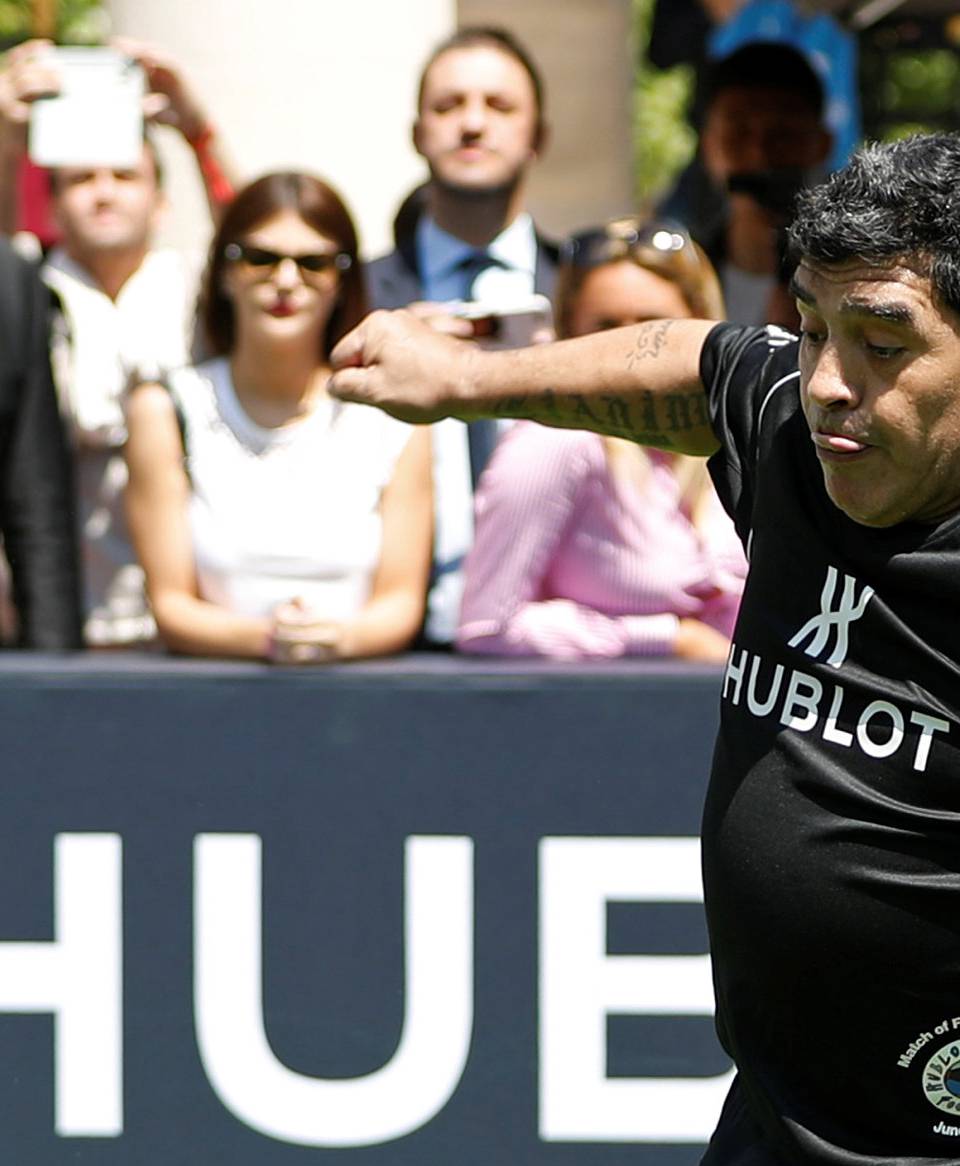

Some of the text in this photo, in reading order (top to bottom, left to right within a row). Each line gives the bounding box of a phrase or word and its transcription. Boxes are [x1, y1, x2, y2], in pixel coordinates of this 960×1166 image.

[723, 643, 950, 772] HUBLOT
[897, 1030, 934, 1068] Match
[934, 1020, 950, 1035] of
